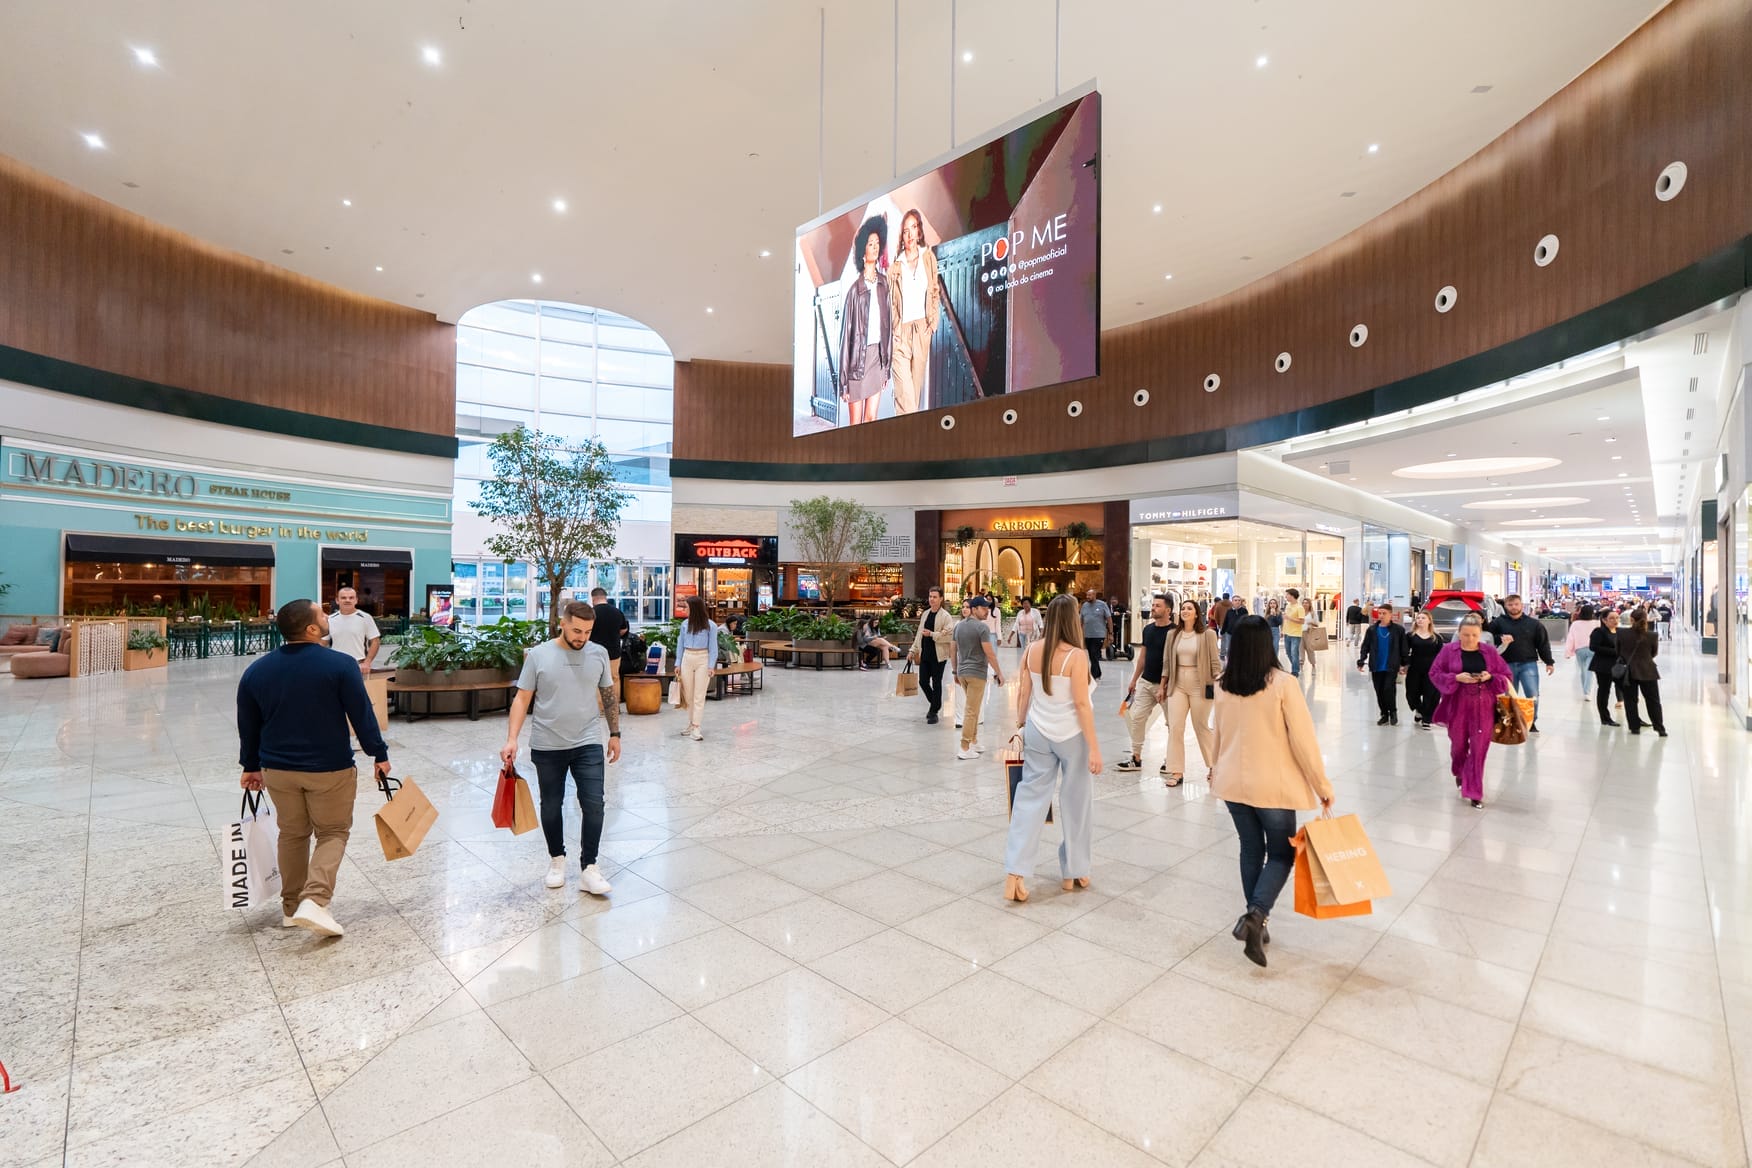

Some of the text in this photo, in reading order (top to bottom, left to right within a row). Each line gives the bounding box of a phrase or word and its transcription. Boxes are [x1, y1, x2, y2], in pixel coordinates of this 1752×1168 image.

[982, 213, 1066, 267] POP ME
[1030, 268, 1053, 280] cinema
[21, 452, 198, 498] MADERO
[209, 484, 291, 502] STEAK HOUSE
[1139, 507, 1226, 520] TOMMY HILFIGER
[134, 513, 369, 543] The best burger in the world
[696, 547, 758, 558] OUTBACK
[1326, 848, 1367, 862] HERING
[232, 848, 248, 908] MADE
